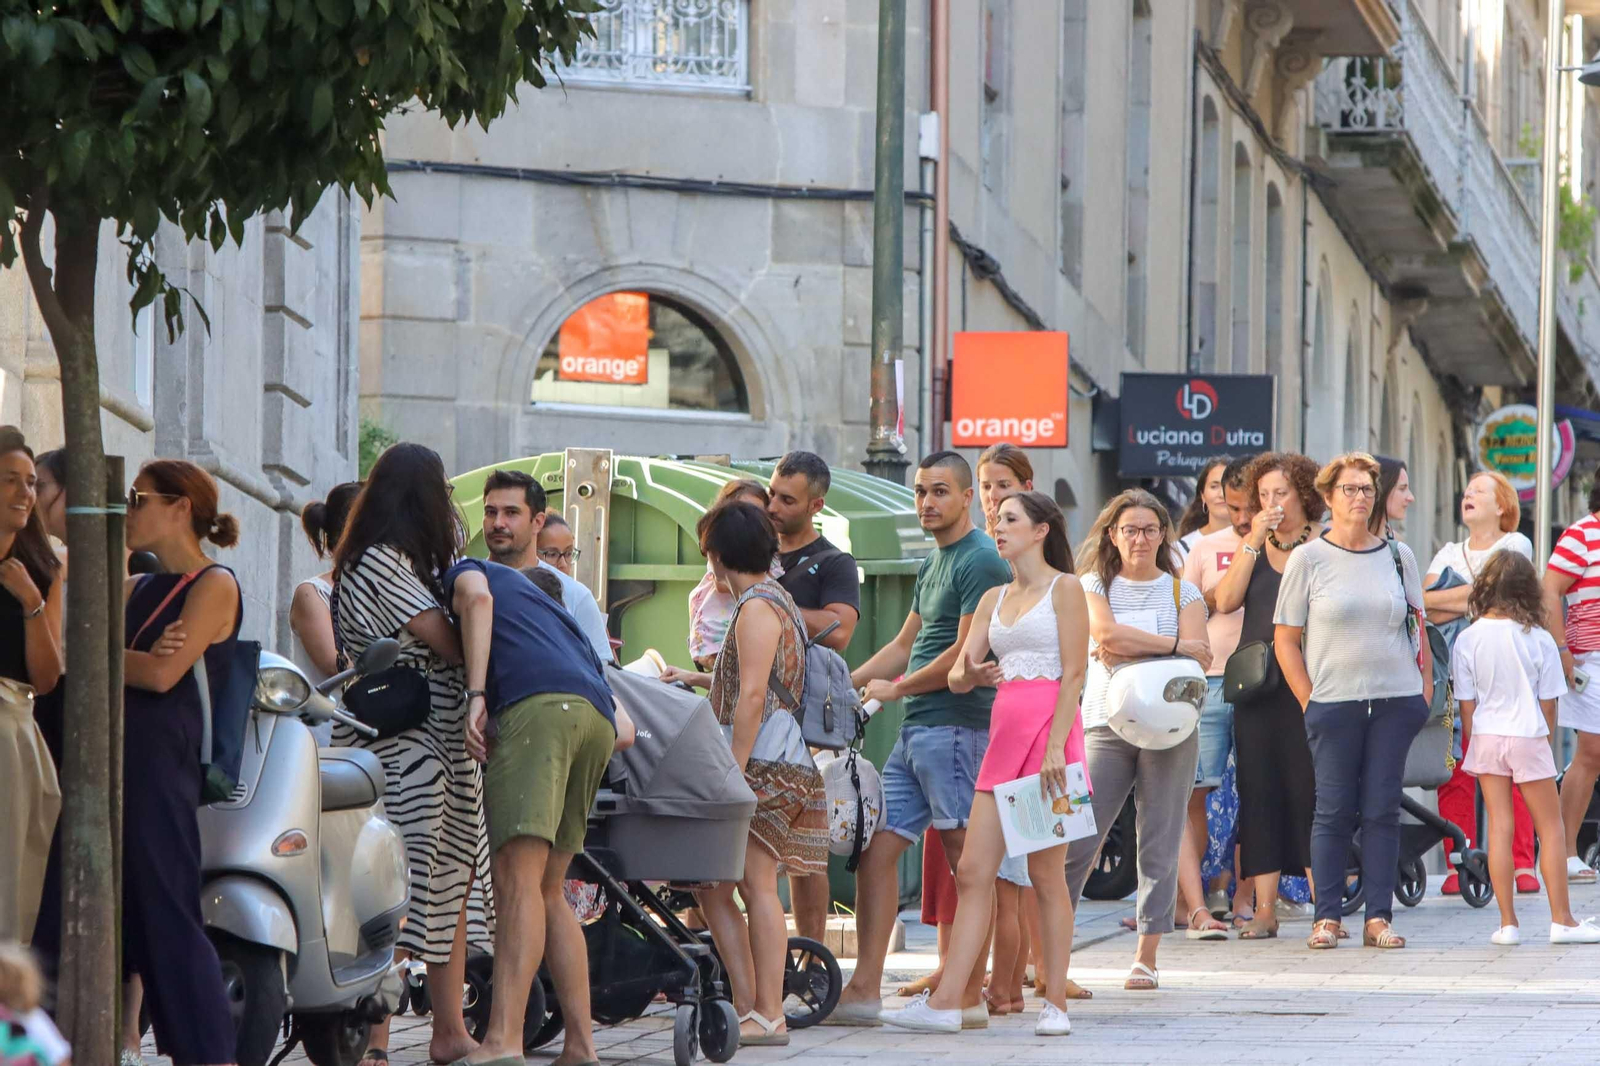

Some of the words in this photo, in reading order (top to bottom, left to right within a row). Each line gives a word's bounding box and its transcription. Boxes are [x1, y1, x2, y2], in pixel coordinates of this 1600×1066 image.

[562, 356, 639, 381] orange
[957, 418, 1055, 443] orange
[1128, 424, 1204, 445] Luciana
[1211, 425, 1264, 446] Dutra
[1156, 450, 1209, 470] Peluqu
